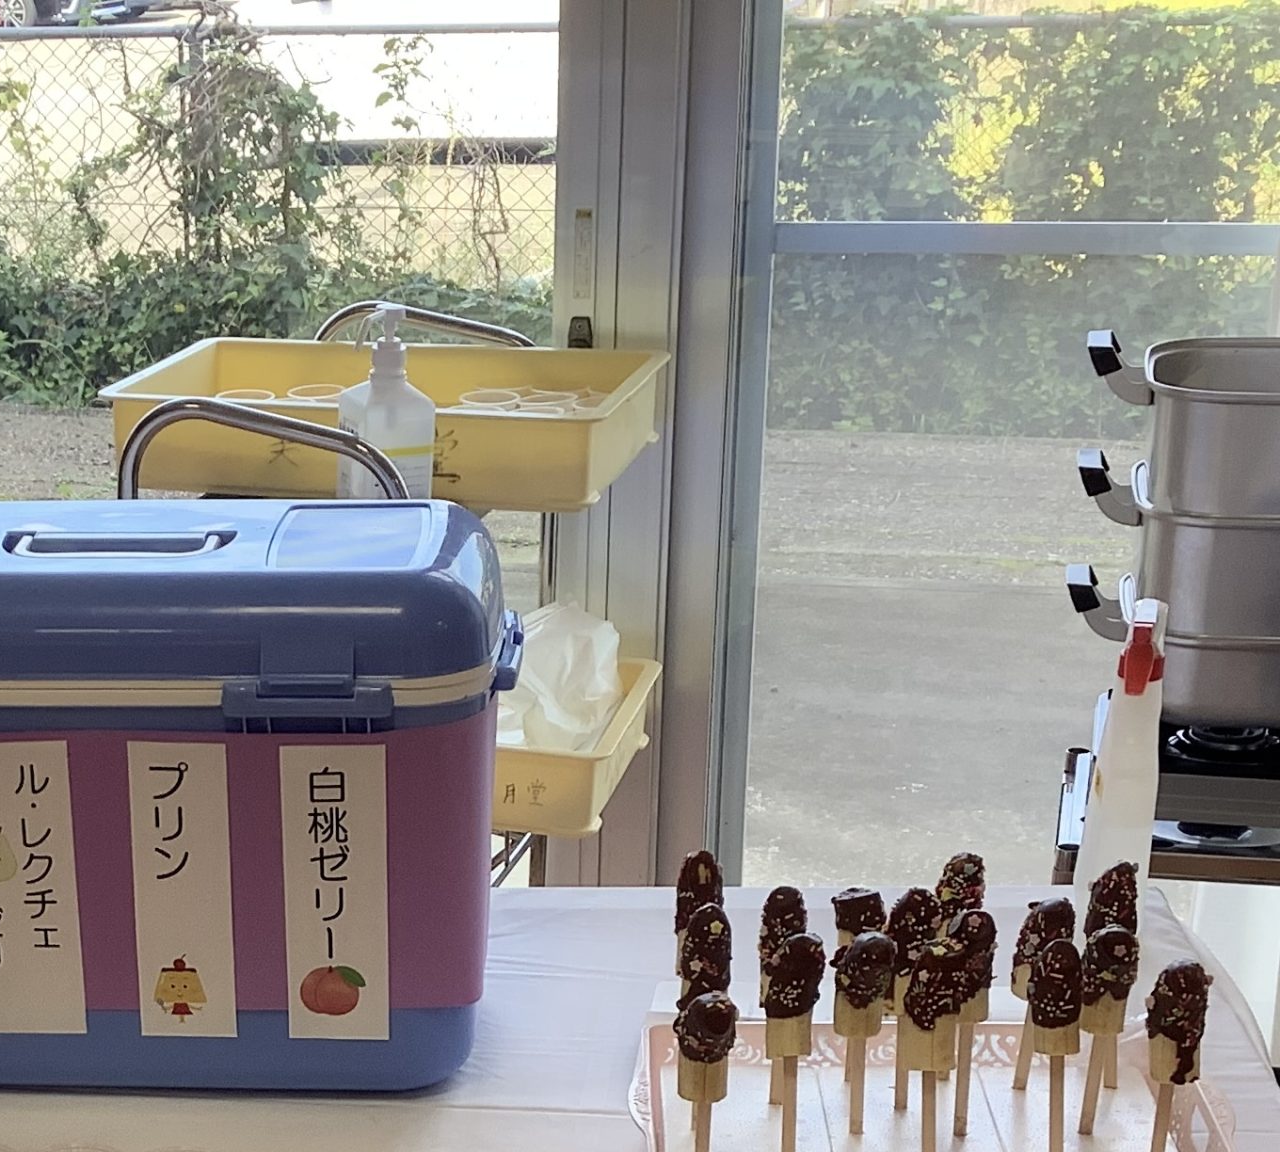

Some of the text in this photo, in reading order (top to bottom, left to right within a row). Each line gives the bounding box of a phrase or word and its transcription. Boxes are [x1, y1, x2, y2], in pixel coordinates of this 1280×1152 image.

[15, 762, 61, 950] ル・レクチェ
[148, 762, 190, 880] プリン
[306, 767, 350, 959] 白桃ゼリー
